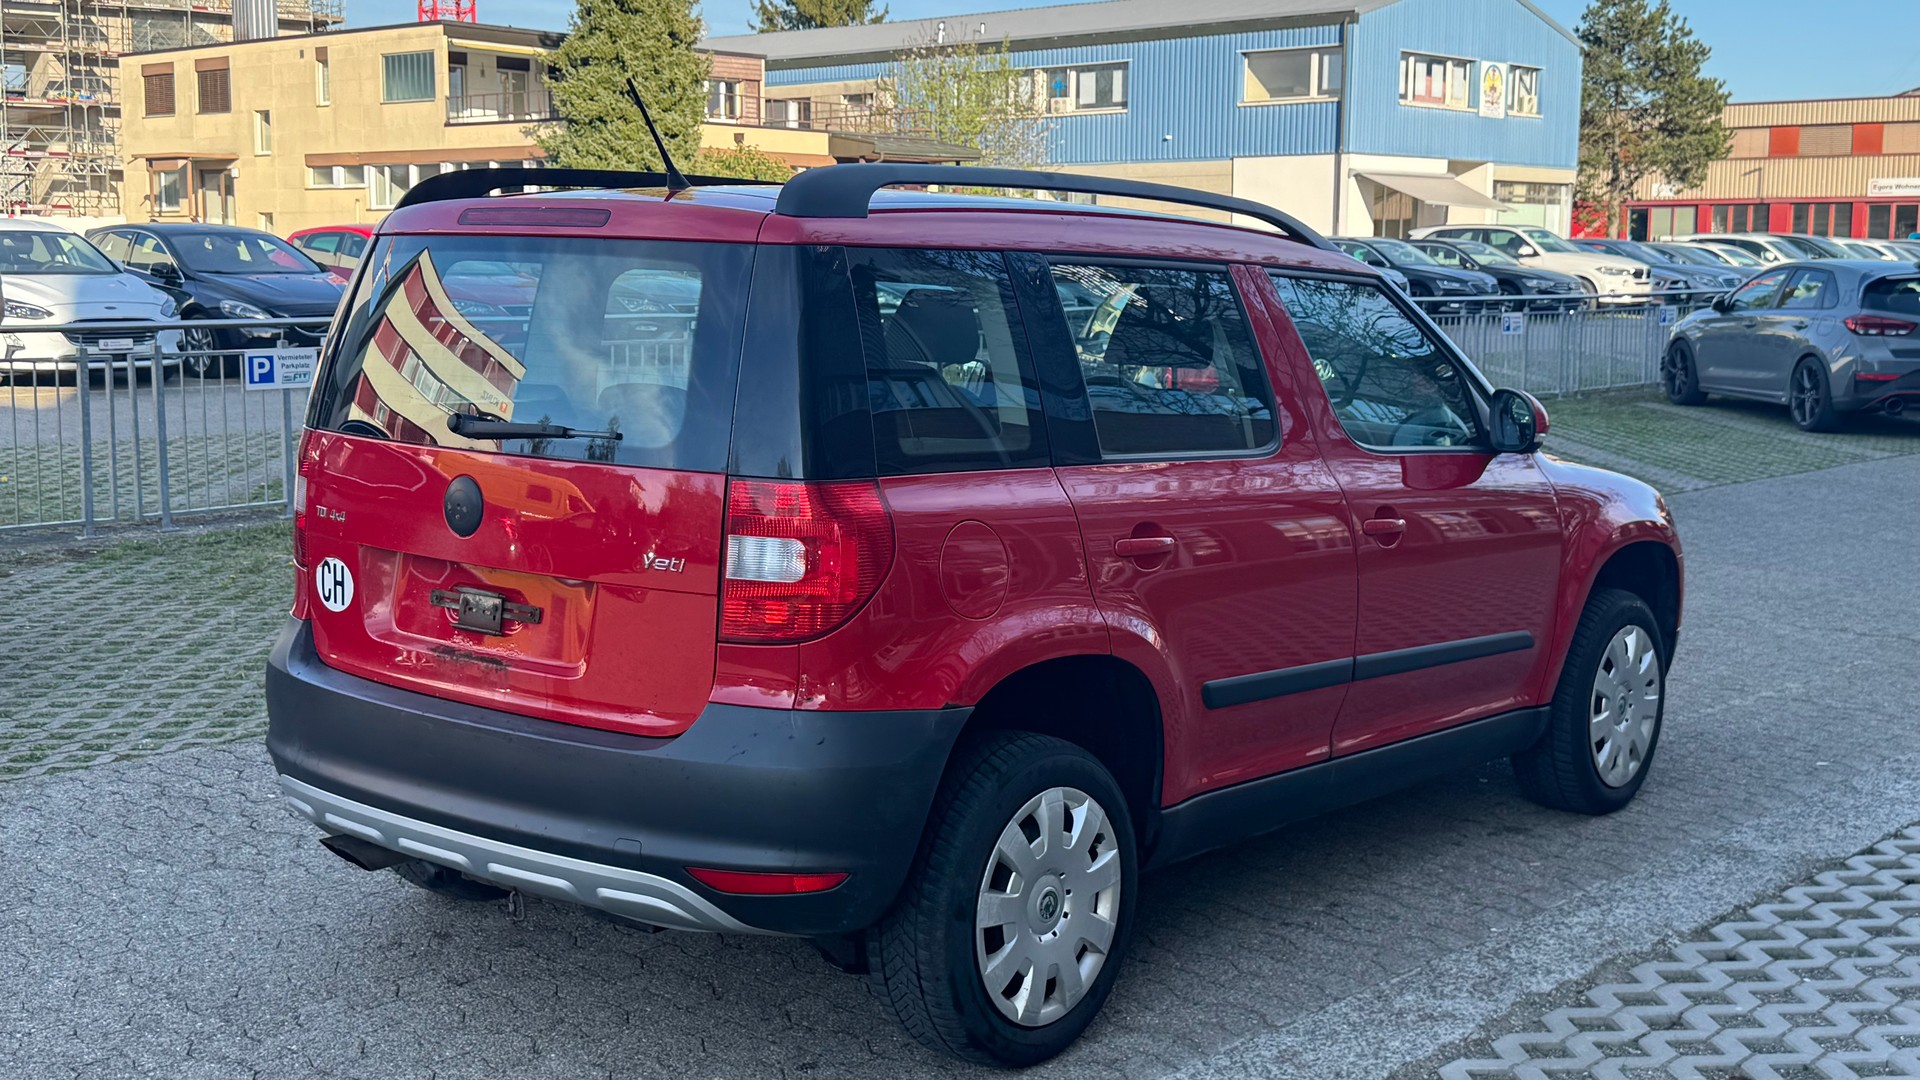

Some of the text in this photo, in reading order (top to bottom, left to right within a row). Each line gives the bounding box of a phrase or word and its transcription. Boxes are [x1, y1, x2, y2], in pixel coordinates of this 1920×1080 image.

[253, 357, 270, 382] P
[281, 362, 310, 370] Parkplatz
[643, 552, 685, 572] Yeti
[321, 560, 345, 606] CH
